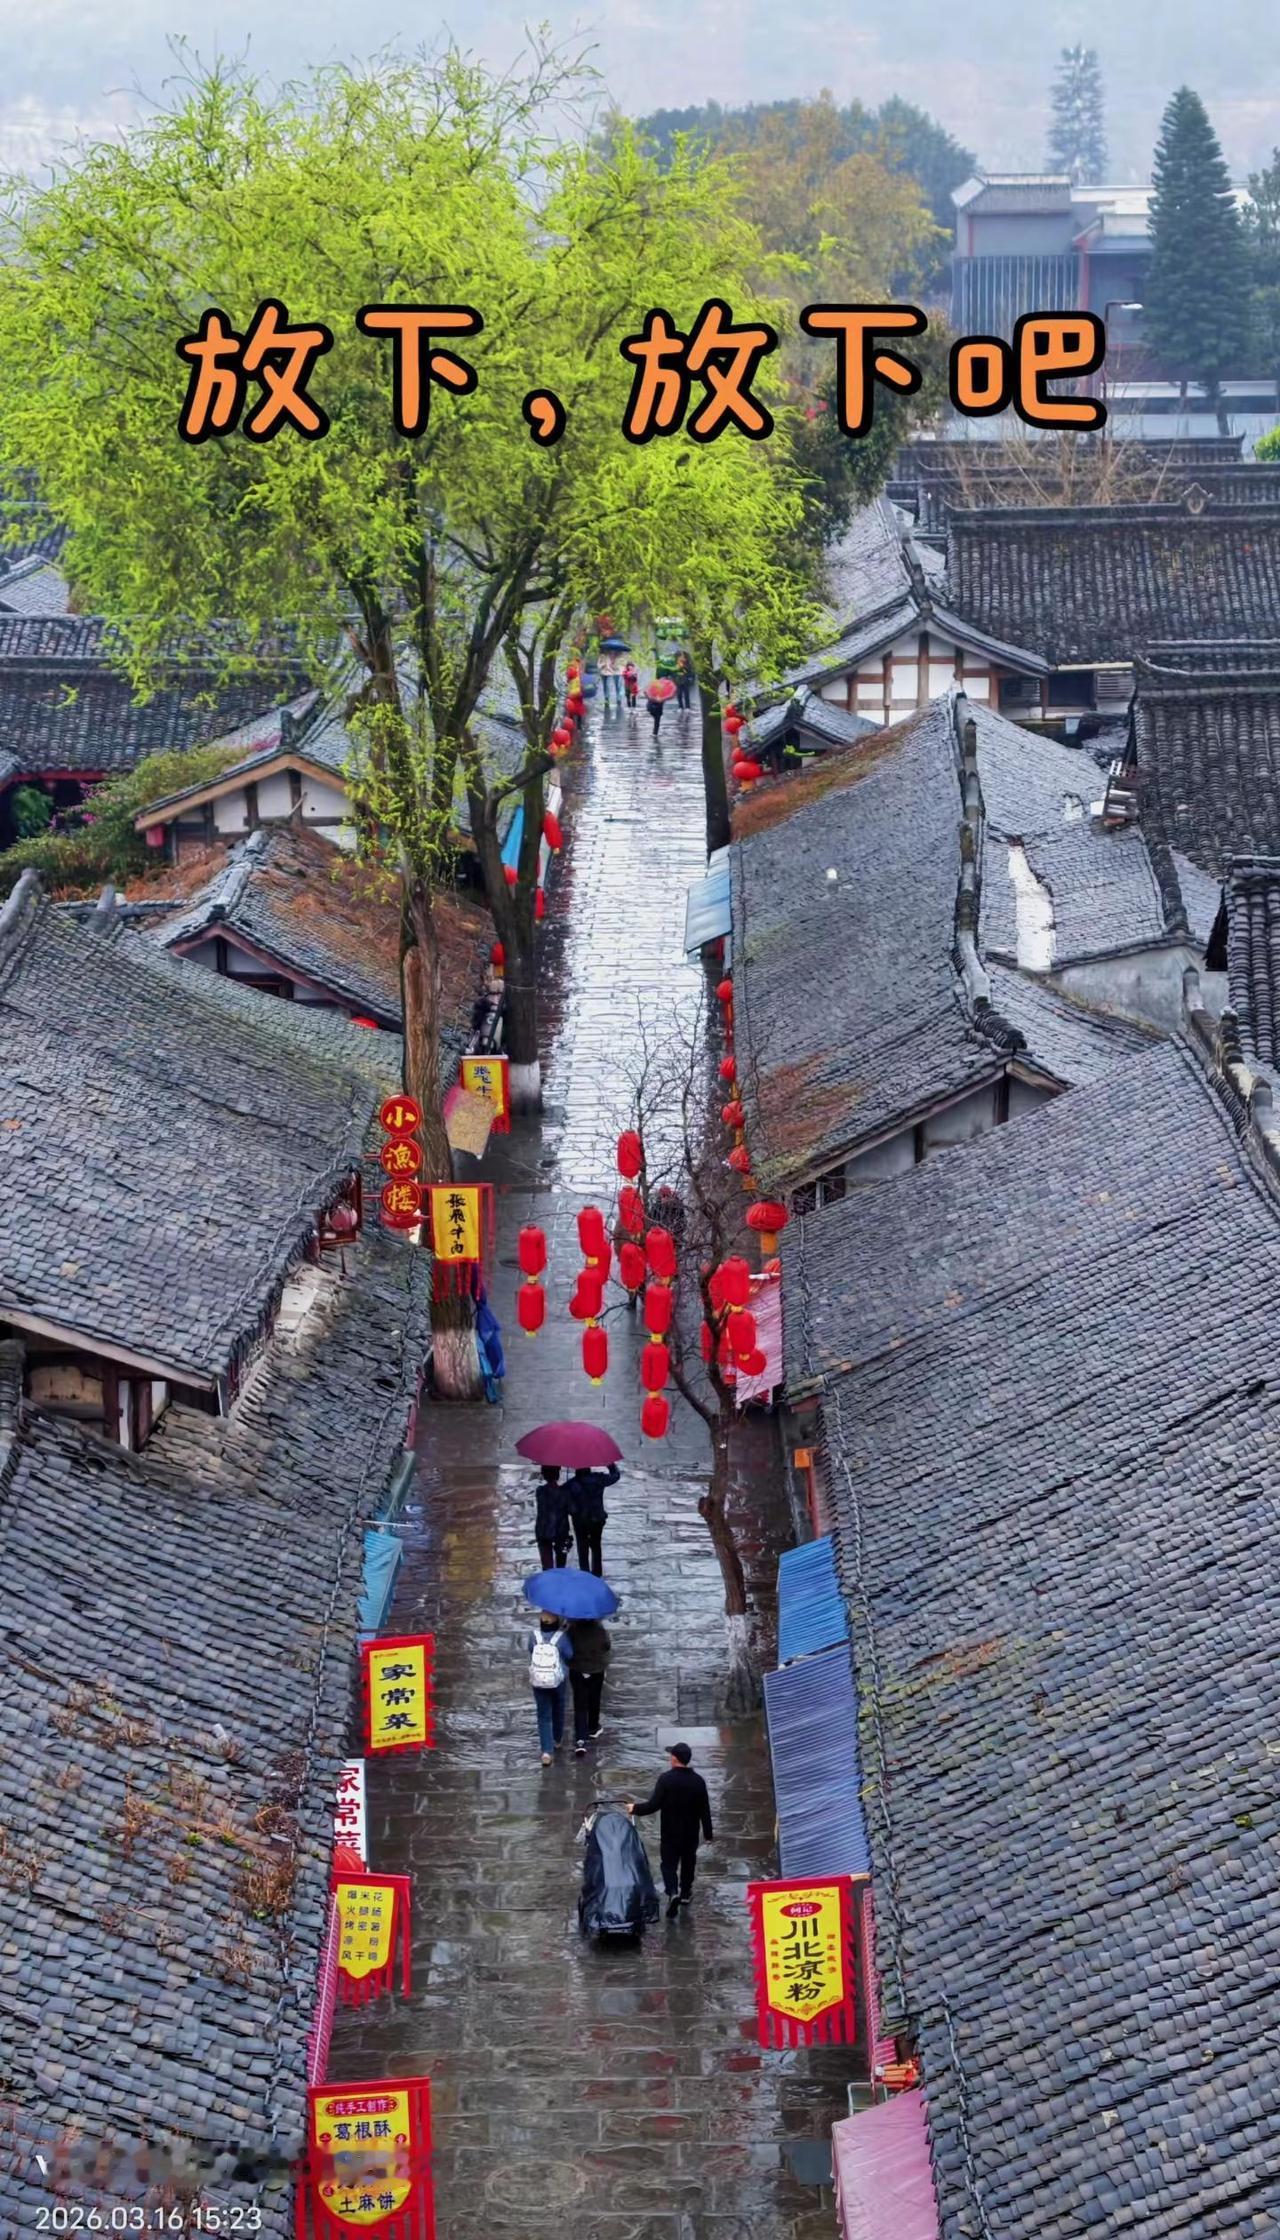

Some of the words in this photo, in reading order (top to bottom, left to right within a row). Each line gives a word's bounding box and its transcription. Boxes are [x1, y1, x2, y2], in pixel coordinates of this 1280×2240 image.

[379, 1664, 417, 1730] 家常菜
[781, 1918, 826, 2001] 川北凉粉
[333, 2119, 392, 2141] 葛根酥
[338, 2192, 396, 2214] 土麻饼
